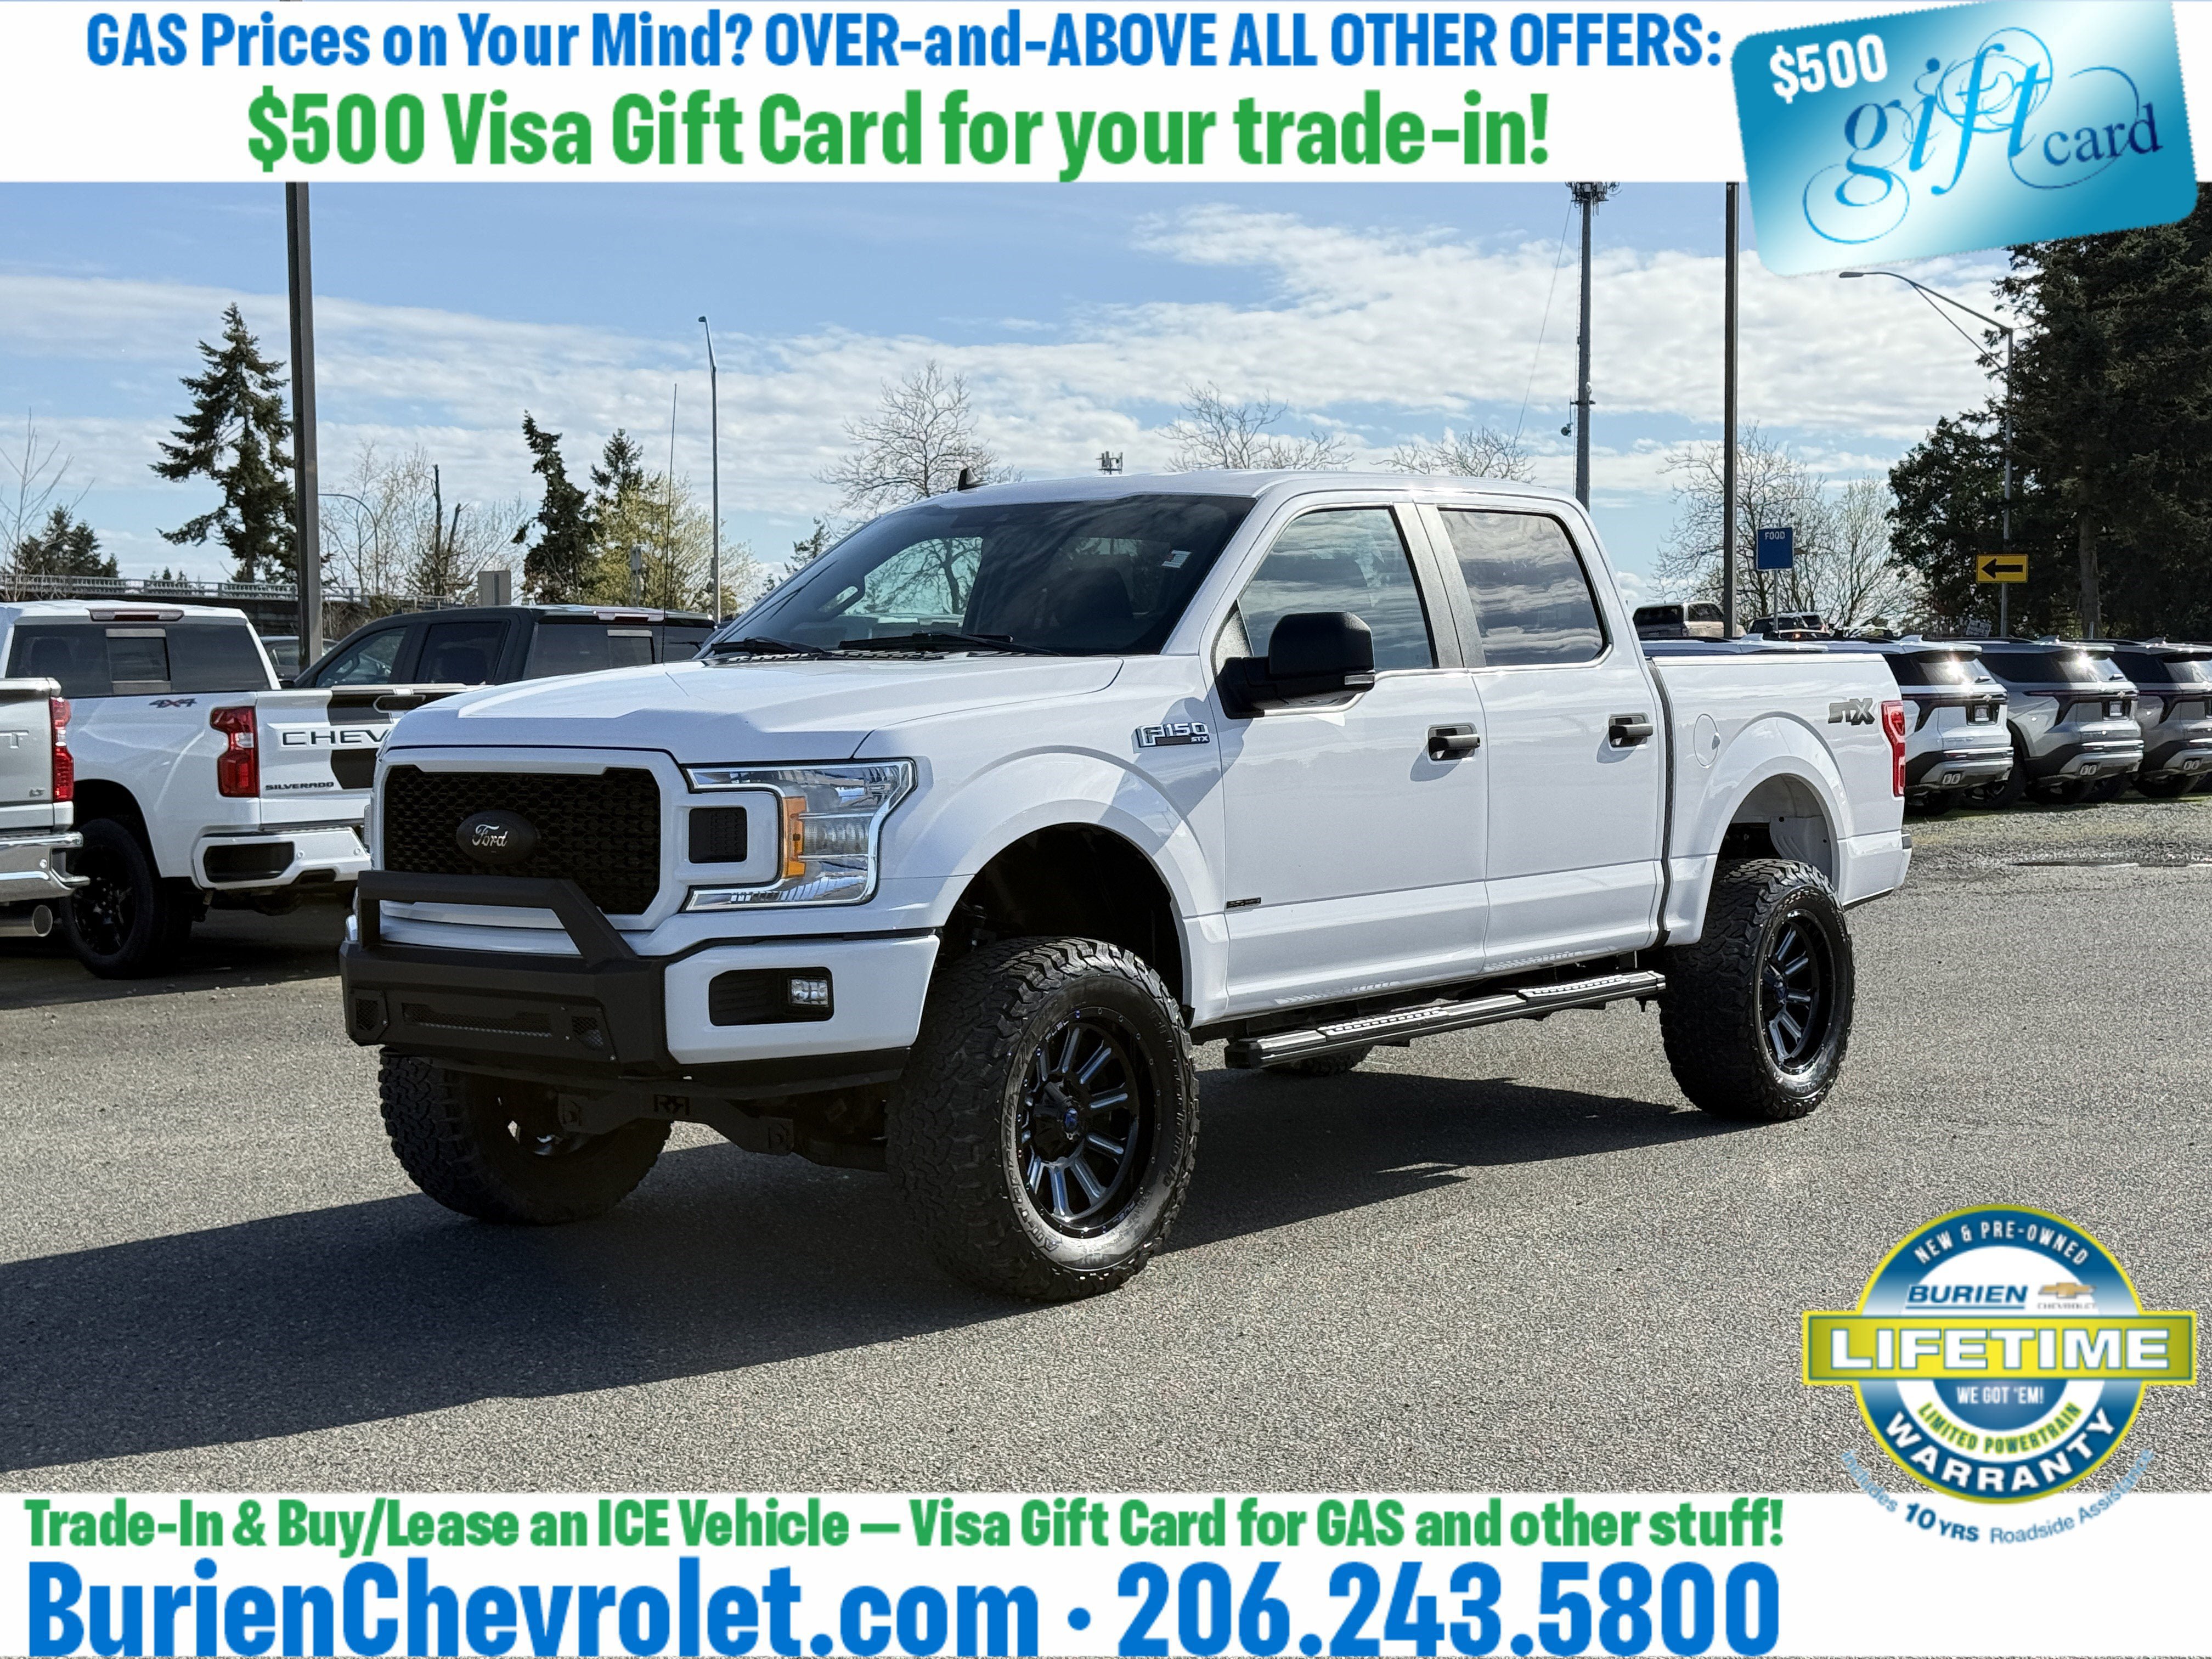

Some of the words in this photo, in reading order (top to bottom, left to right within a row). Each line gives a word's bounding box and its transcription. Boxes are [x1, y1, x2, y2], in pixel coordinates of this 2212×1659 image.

[1764, 531, 1785, 540] FOOD
[1828, 698, 1875, 725] STX
[266, 782, 334, 791] SILVERADO
[472, 824, 509, 847] Ford
